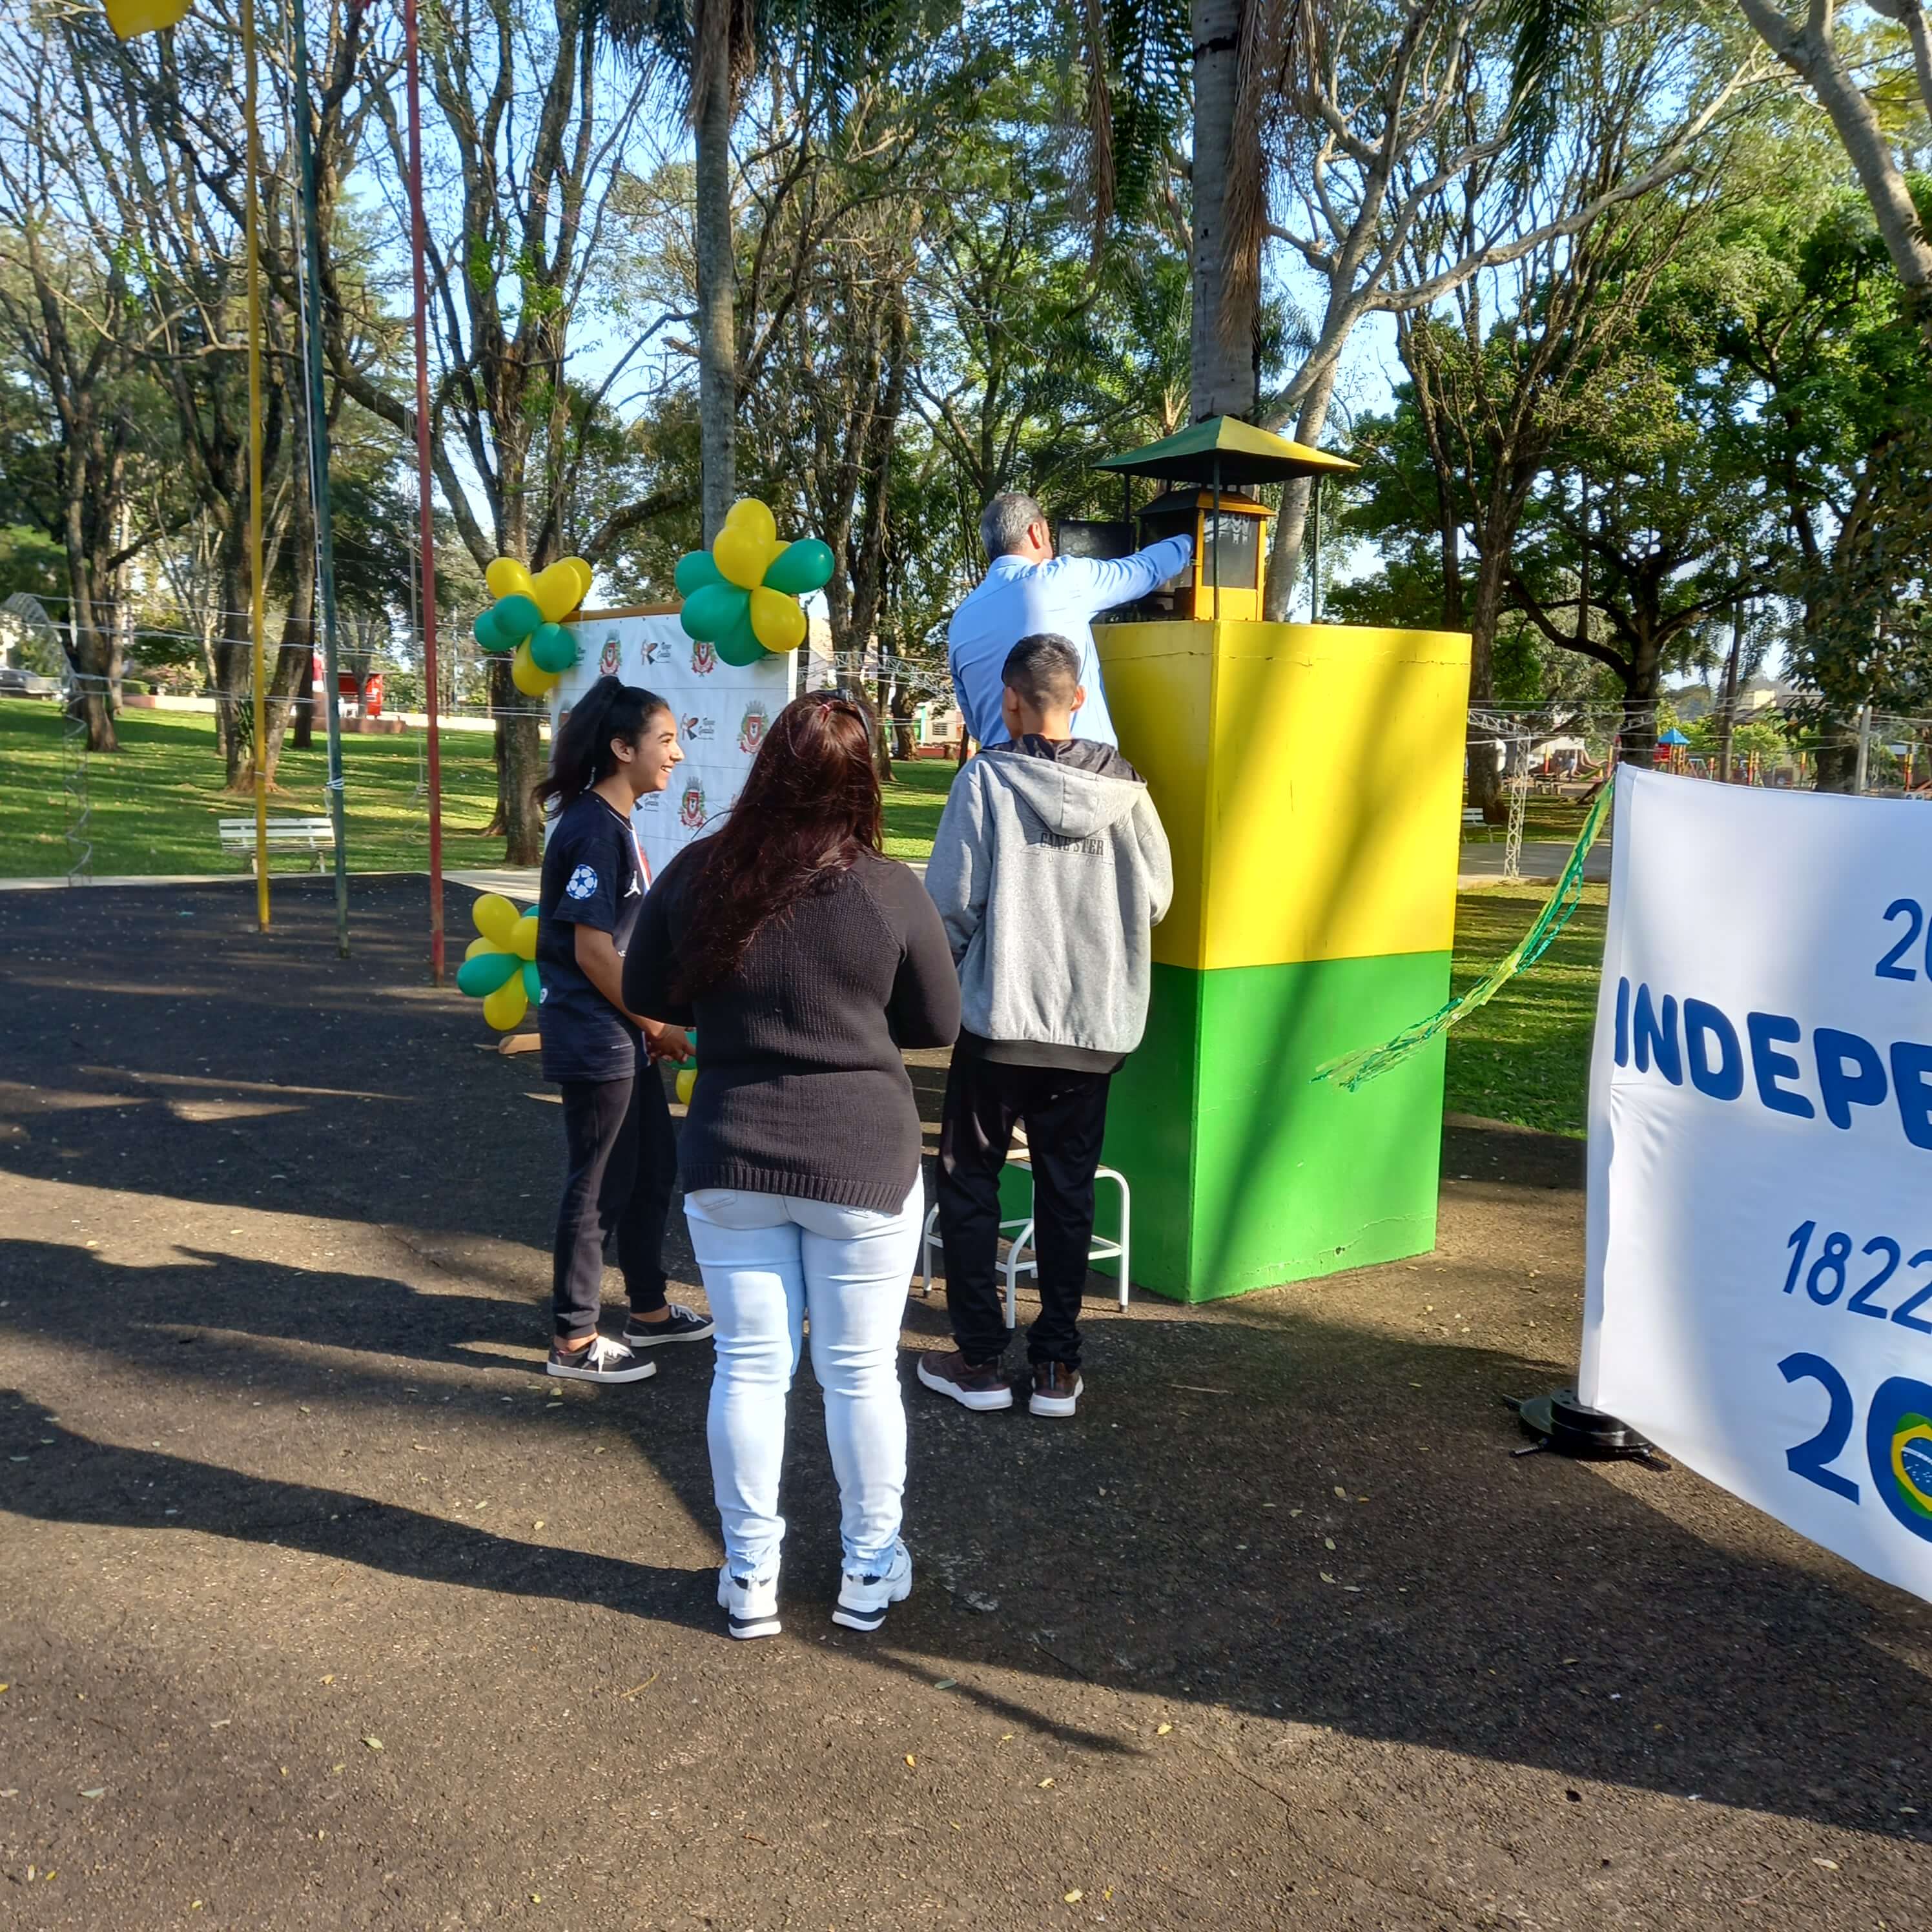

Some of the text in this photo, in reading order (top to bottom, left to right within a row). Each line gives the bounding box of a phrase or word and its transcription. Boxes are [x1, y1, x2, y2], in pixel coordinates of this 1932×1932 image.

[1875, 898, 1932, 982] 2
[1614, 978, 1932, 1151] INDEPE
[1782, 1220, 1932, 1335] 1822
